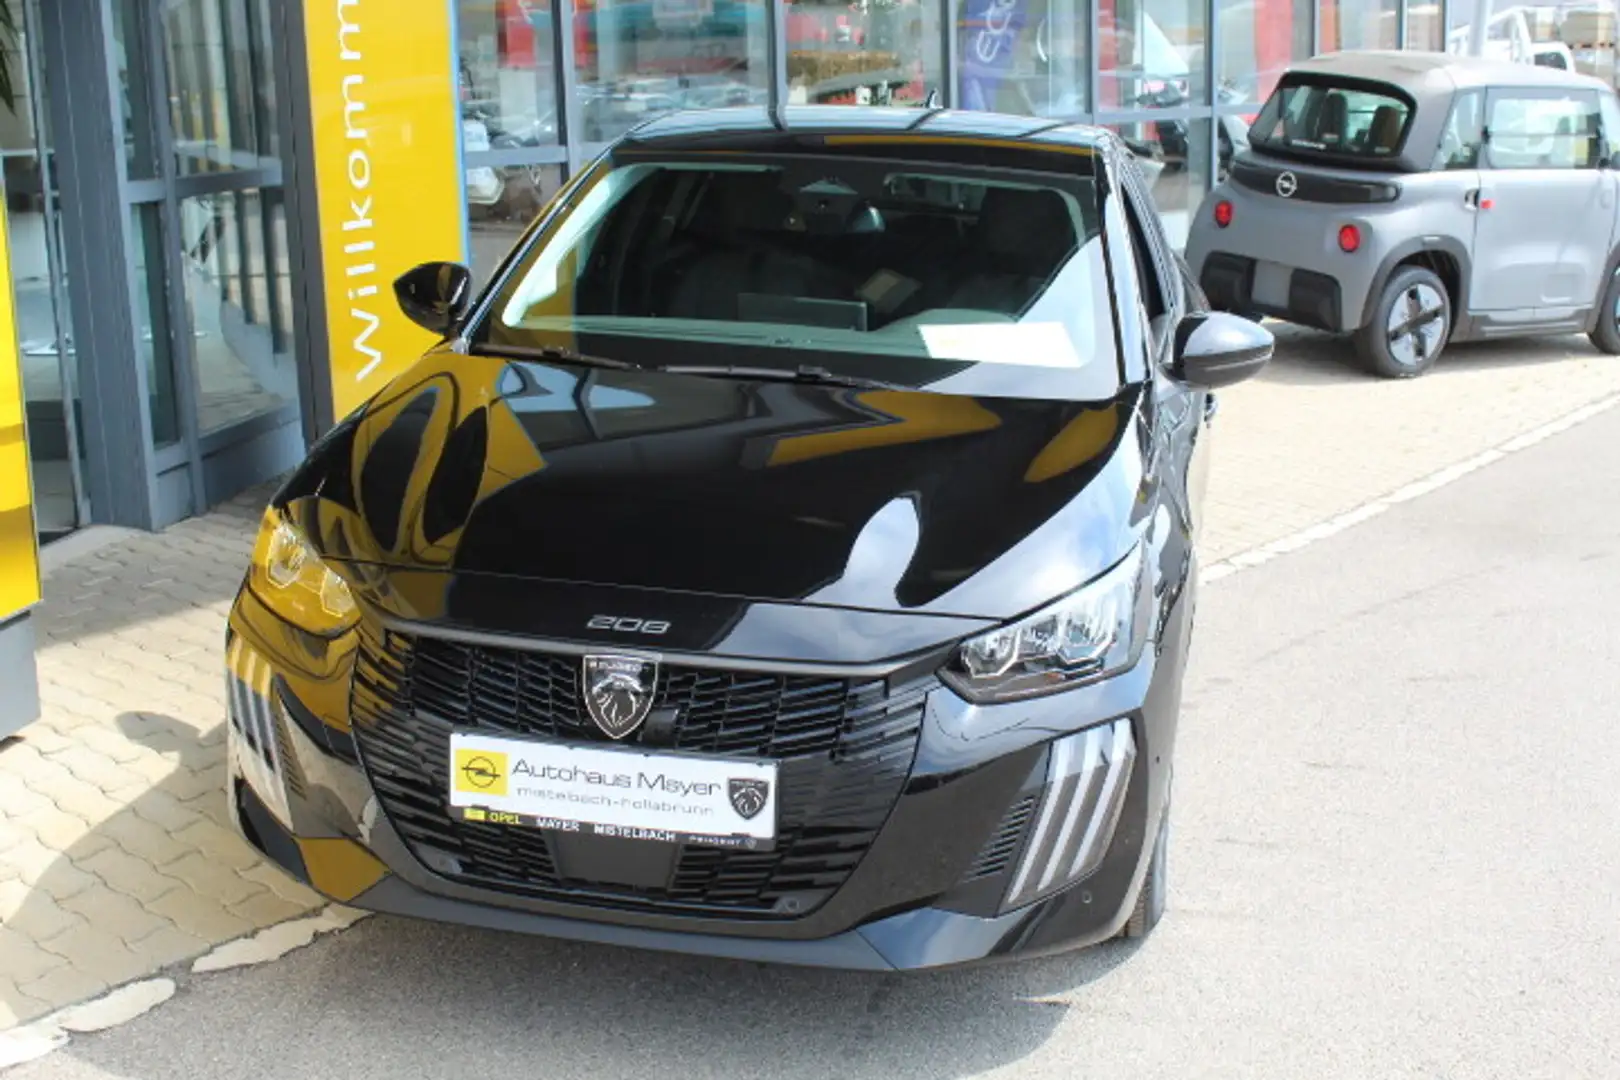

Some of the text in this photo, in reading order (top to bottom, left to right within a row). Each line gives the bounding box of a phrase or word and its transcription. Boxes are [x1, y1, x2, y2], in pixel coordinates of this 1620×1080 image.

[586, 613, 671, 634] 208
[512, 758, 722, 797] Autohaus Mayer
[489, 811, 522, 825] OPEL
[536, 816, 580, 832] MAYER
[594, 823, 677, 842] MISTELBACH
